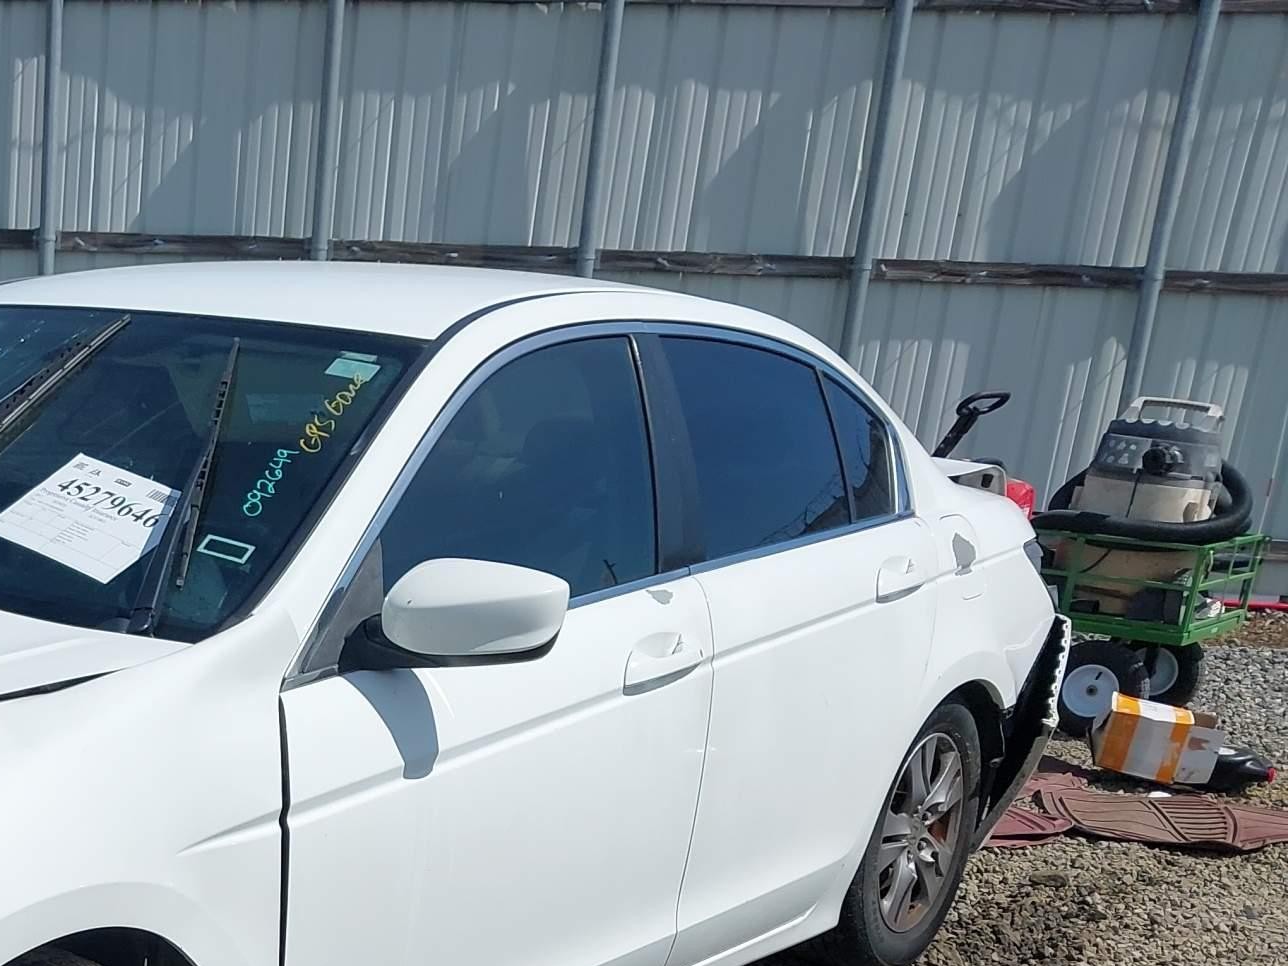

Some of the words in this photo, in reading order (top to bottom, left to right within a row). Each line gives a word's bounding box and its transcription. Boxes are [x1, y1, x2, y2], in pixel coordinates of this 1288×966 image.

[299, 414, 335, 453] GPS
[57, 478, 168, 529] 45279646
[242, 448, 300, 517] 092649
